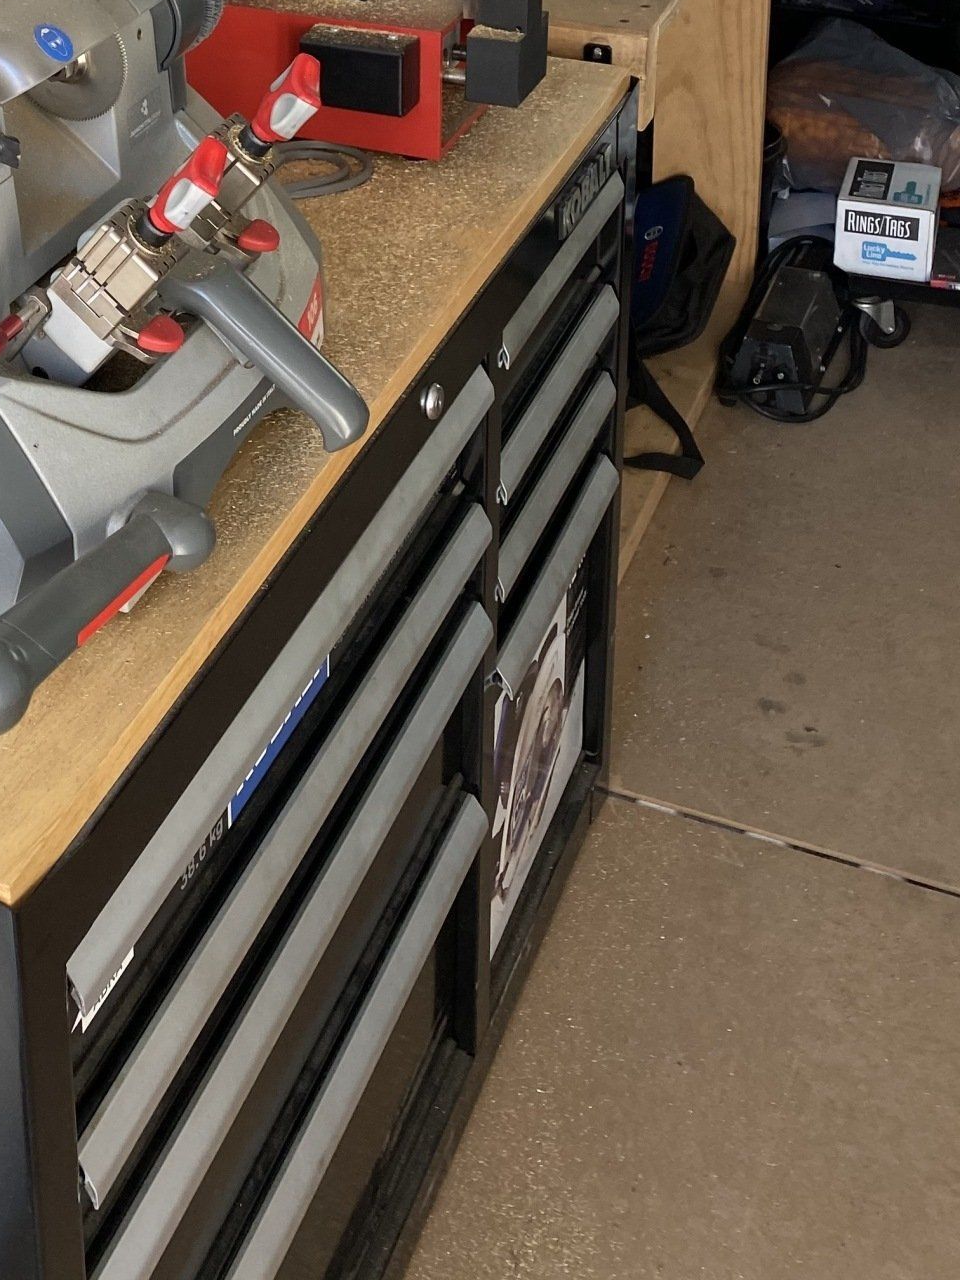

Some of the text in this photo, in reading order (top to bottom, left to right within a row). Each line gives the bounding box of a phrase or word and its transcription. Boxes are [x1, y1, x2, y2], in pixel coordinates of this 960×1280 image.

[559, 142, 613, 240] KOBALT
[847, 211, 912, 238] RINGS/TAGS
[863, 243, 886, 254] Lucky
[866, 251, 882, 260] Line
[209, 818, 223, 847] kg
